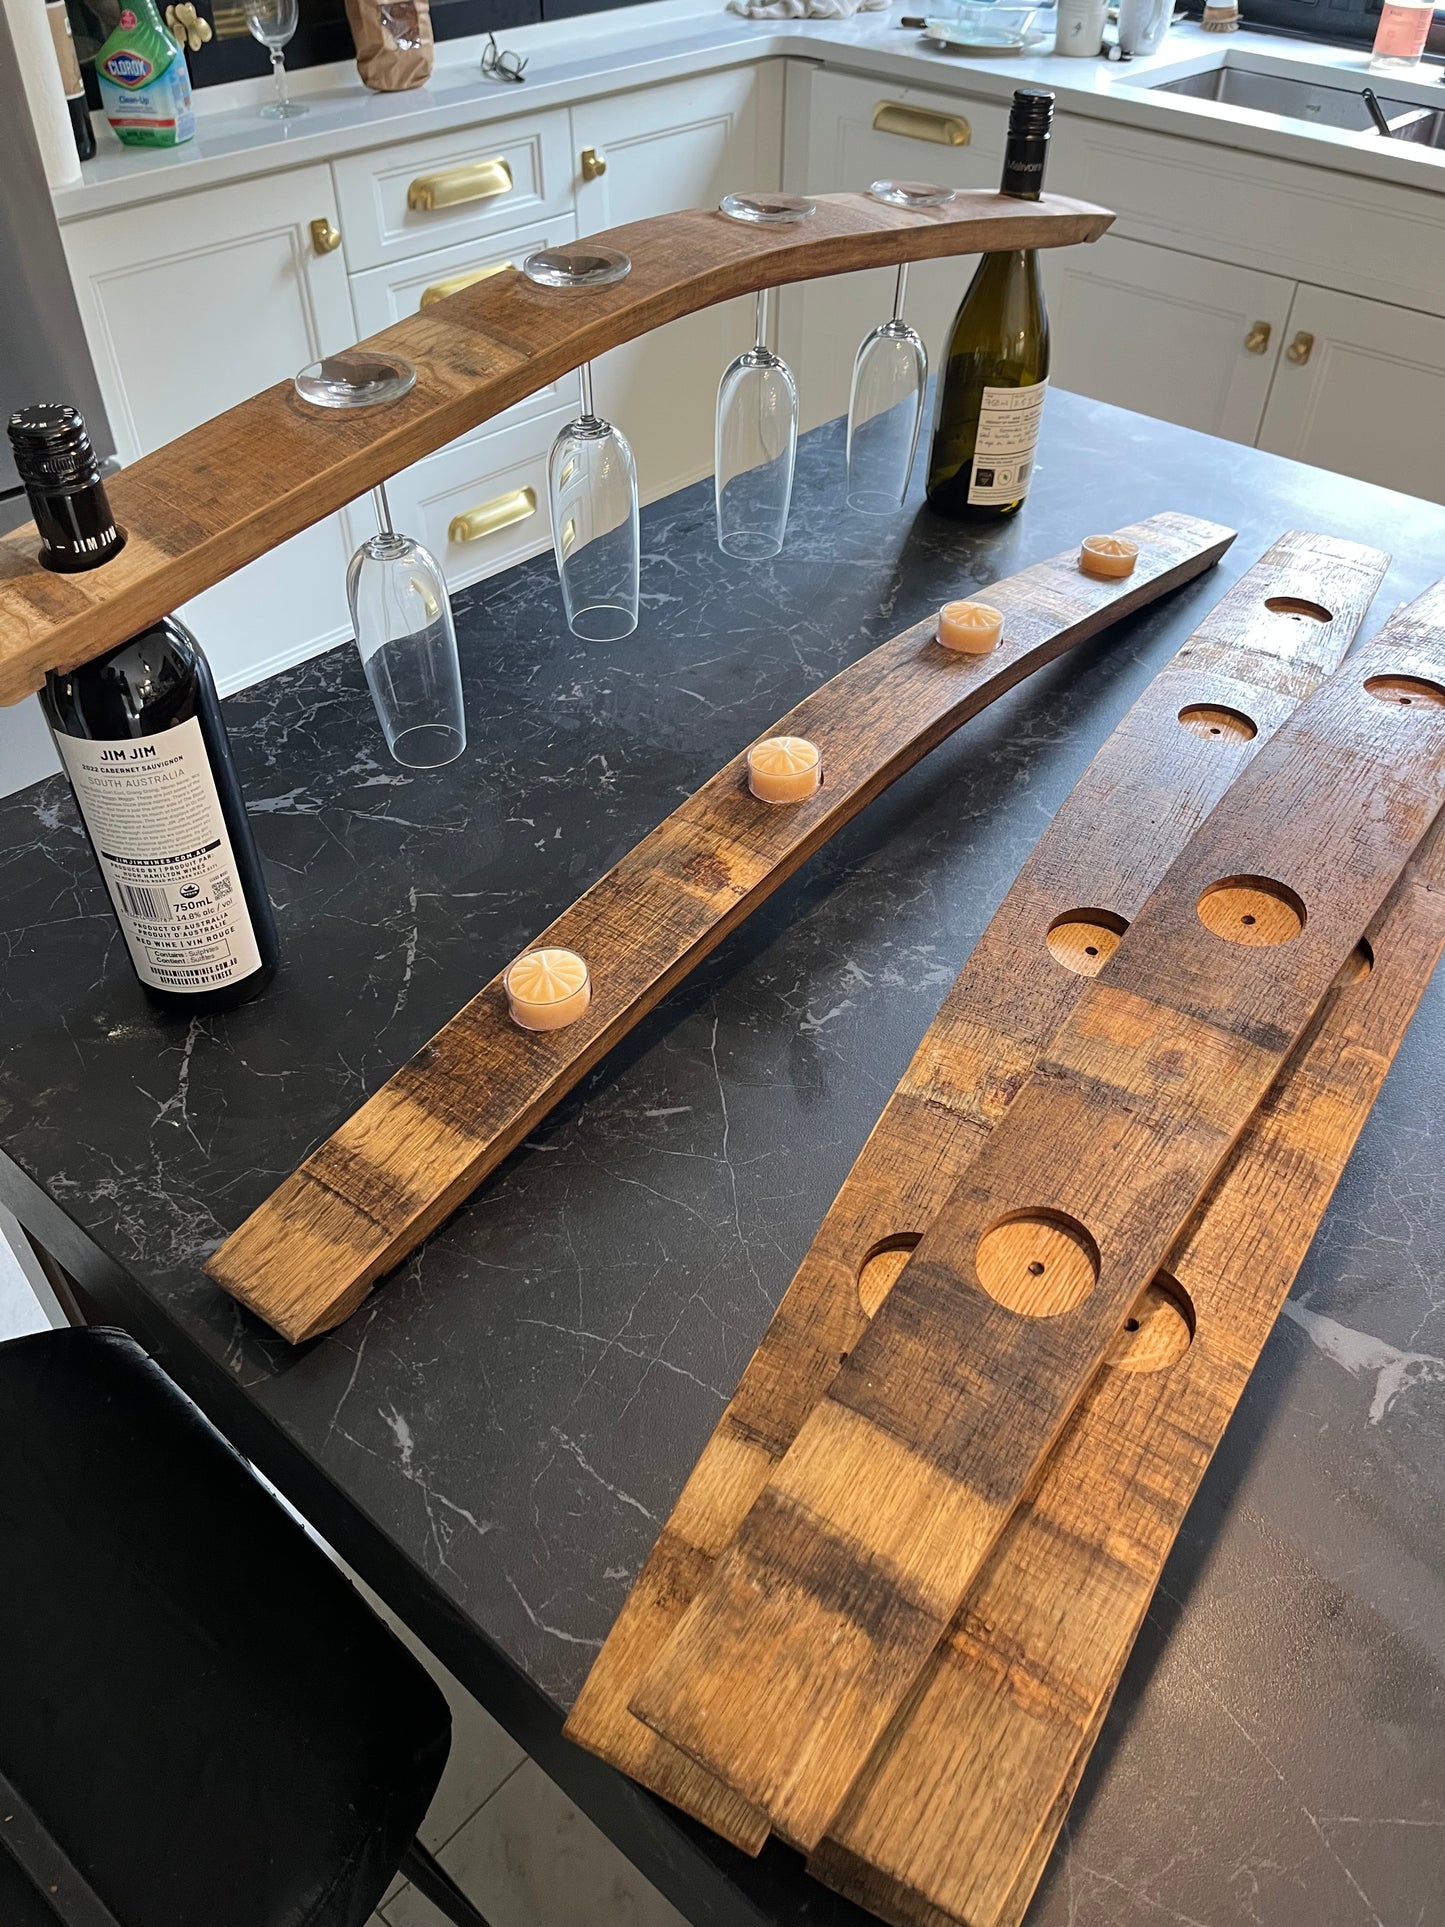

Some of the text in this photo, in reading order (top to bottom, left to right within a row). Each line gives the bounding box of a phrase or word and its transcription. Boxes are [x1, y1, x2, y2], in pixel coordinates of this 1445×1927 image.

[107, 59, 147, 76] CLOROX
[73, 536, 98, 553] JIM
[100, 745, 156, 761] JIM JIM
[81, 755, 184, 774] 2022 CABERNET SAUVIGNON
[88, 768, 185, 788] SOUTH AUSTRALIA
[115, 848, 206, 865] JIMJIMWINES.COM.AU
[110, 862, 145, 873] PRODUCED
[165, 860, 196, 871] PRODUIT
[144, 870, 181, 879] HAMILTON
[183, 863, 206, 874] WINES
[173, 897, 213, 912] 750mL
[176, 912, 201, 922] 14.8%
[203, 907, 215, 916] alc
[222, 898, 233, 908] vol
[133, 921, 168, 932] PRODUCT
[184, 912, 228, 930] AUSTRALIA
[138, 920, 227, 938] PRODUIT D'AUSTRALIE
[135, 936, 151, 945] RED
[186, 938, 203, 947] VIN
[206, 926, 235, 942] ROUGE
